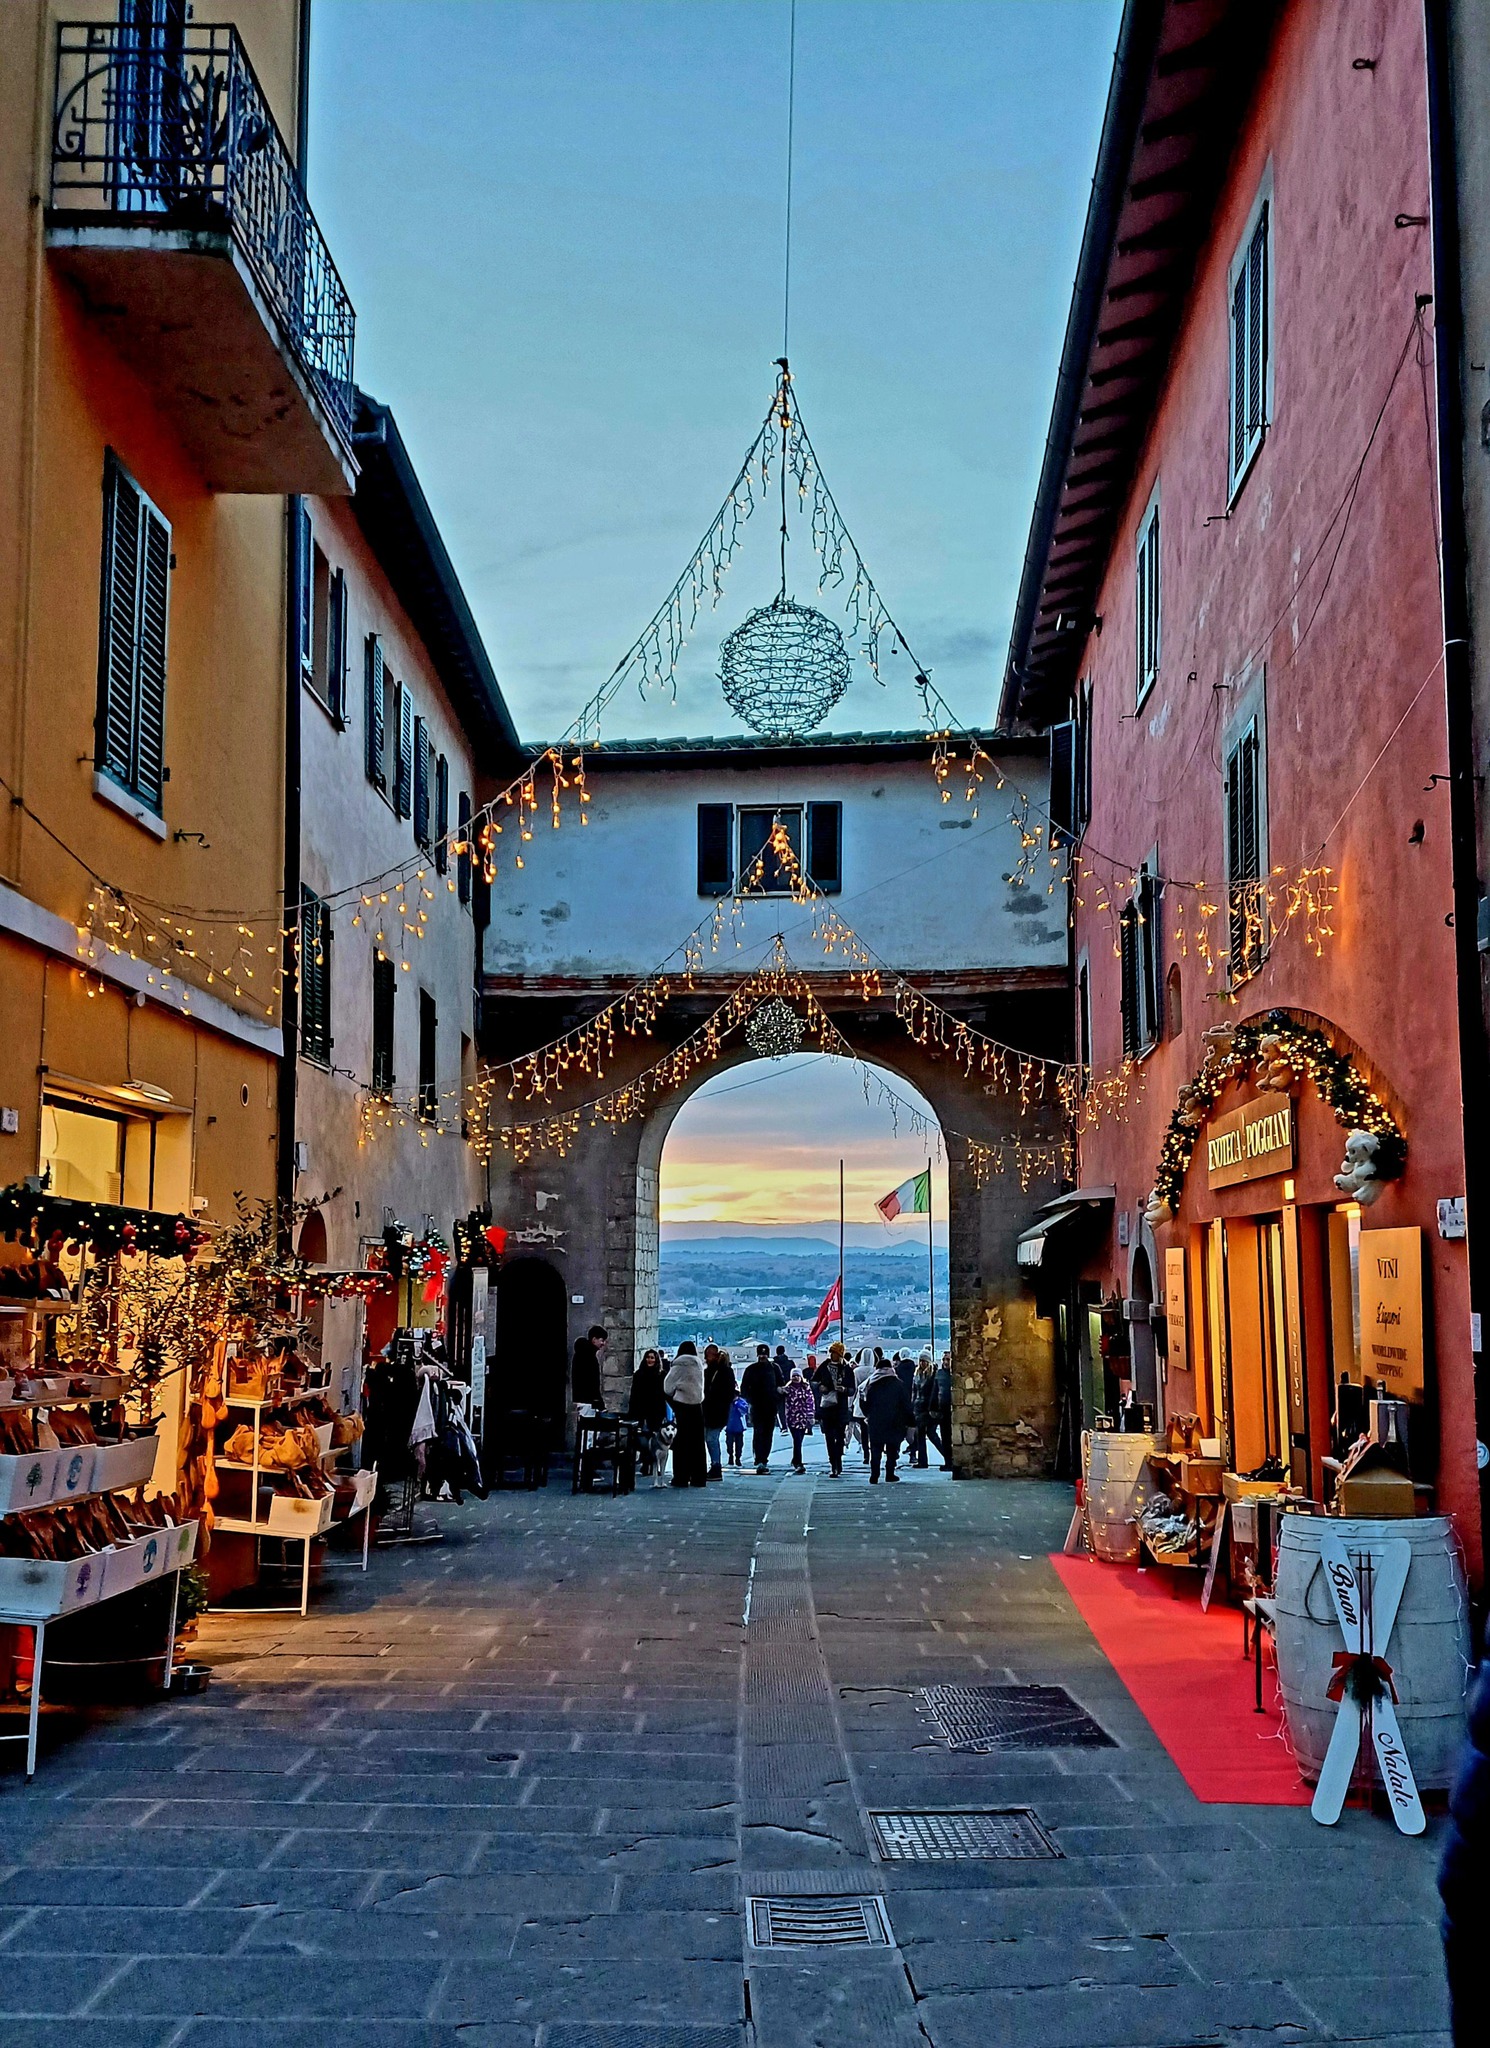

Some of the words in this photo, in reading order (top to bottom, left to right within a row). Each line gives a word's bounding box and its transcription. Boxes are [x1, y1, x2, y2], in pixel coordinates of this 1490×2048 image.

[1208, 1129, 1242, 1171] ENOTECA
[1246, 1108, 1291, 1158] POGGIANI
[1377, 1258, 1398, 1279] VINI
[1376, 1301, 1402, 1334] Liquori
[1371, 1344, 1408, 1361] WORLDWIDE
[1376, 1362, 1404, 1379] SHIPPING
[1328, 1560, 1358, 1627] Buon
[1377, 1732, 1414, 1807] Natale
